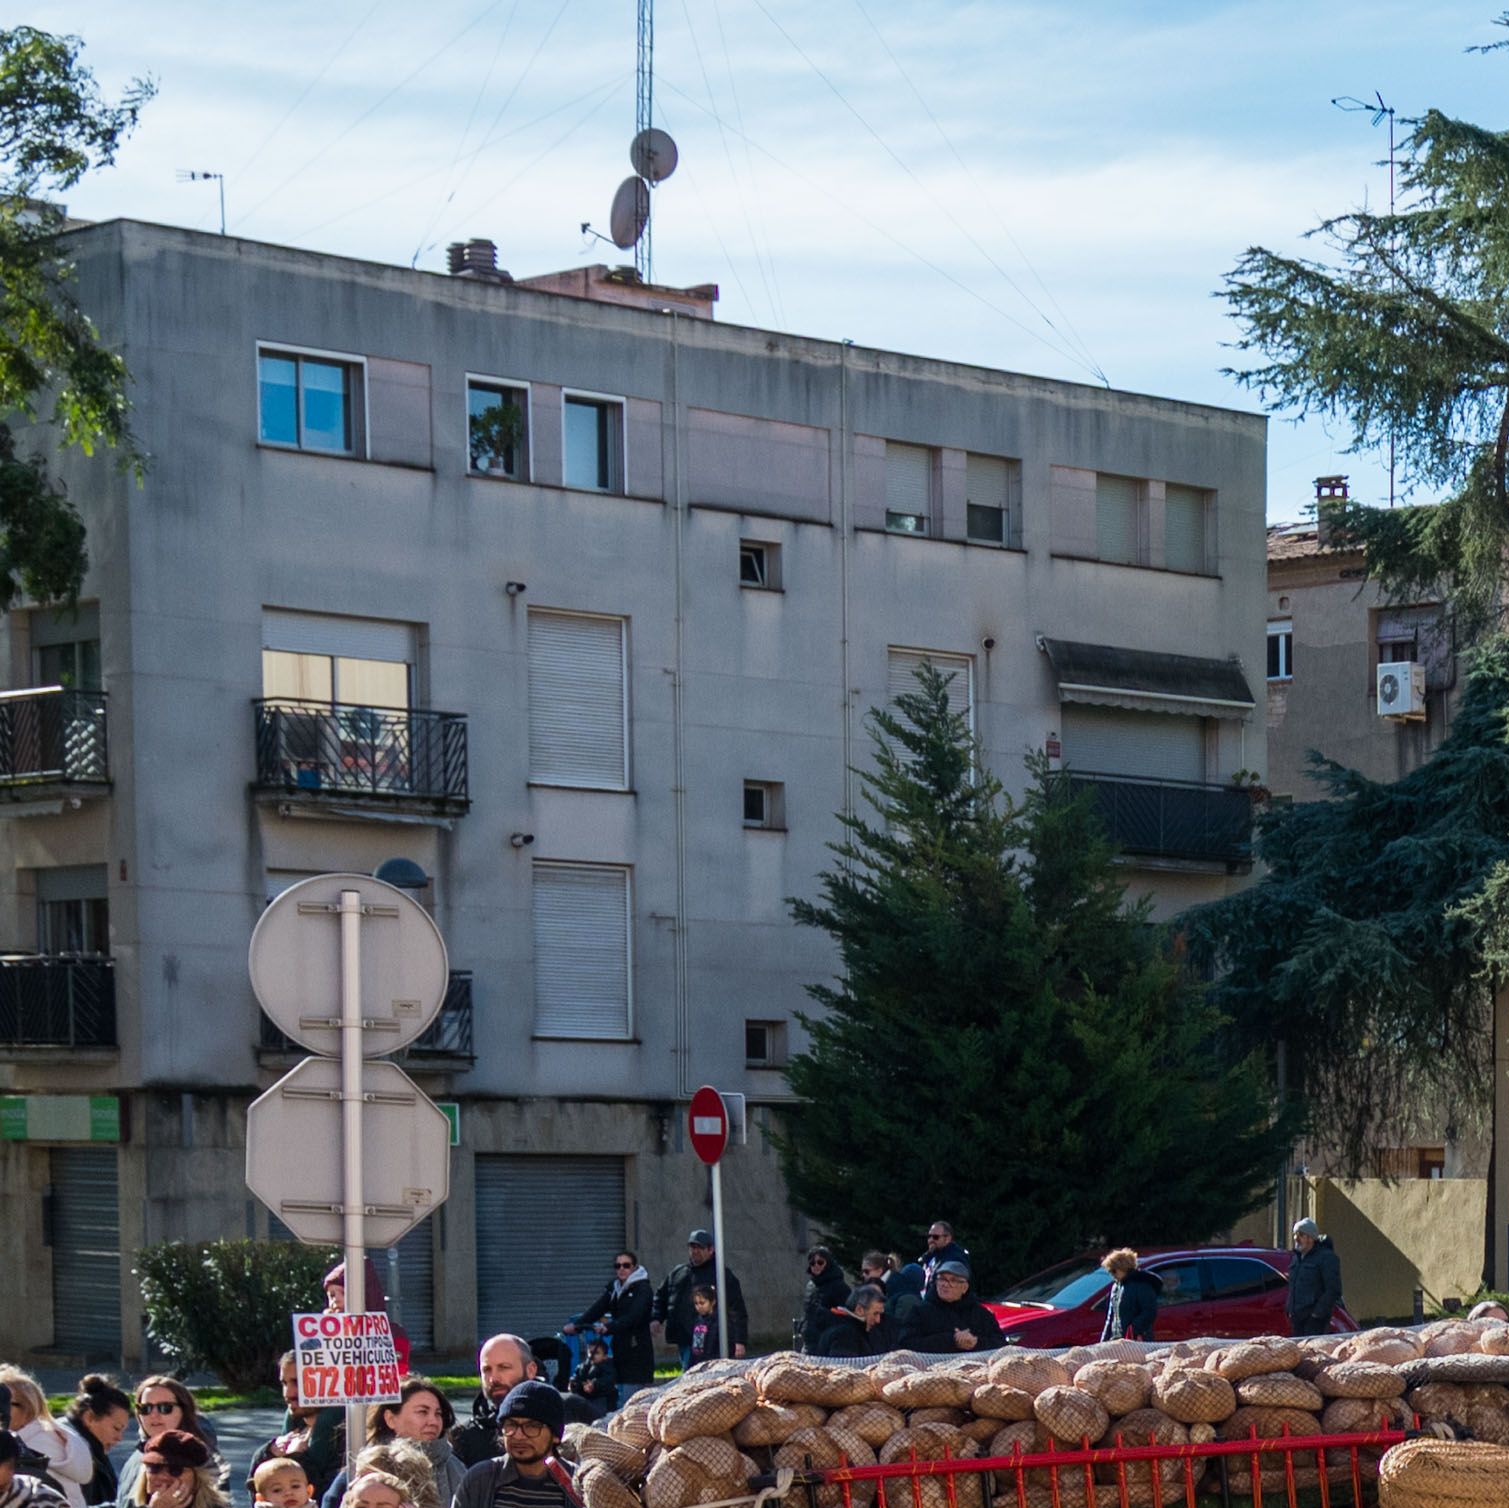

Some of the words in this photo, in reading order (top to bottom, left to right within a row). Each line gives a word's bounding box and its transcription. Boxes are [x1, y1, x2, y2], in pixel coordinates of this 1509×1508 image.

[299, 1315, 389, 1338] COMPRO
[323, 1338, 362, 1349] TODO
[366, 1337, 384, 1348] TIPO
[302, 1352, 324, 1366] DE
[329, 1349, 396, 1366] VEHÍCULOS
[302, 1366, 339, 1398] 672
[344, 1365, 376, 1397] 803
